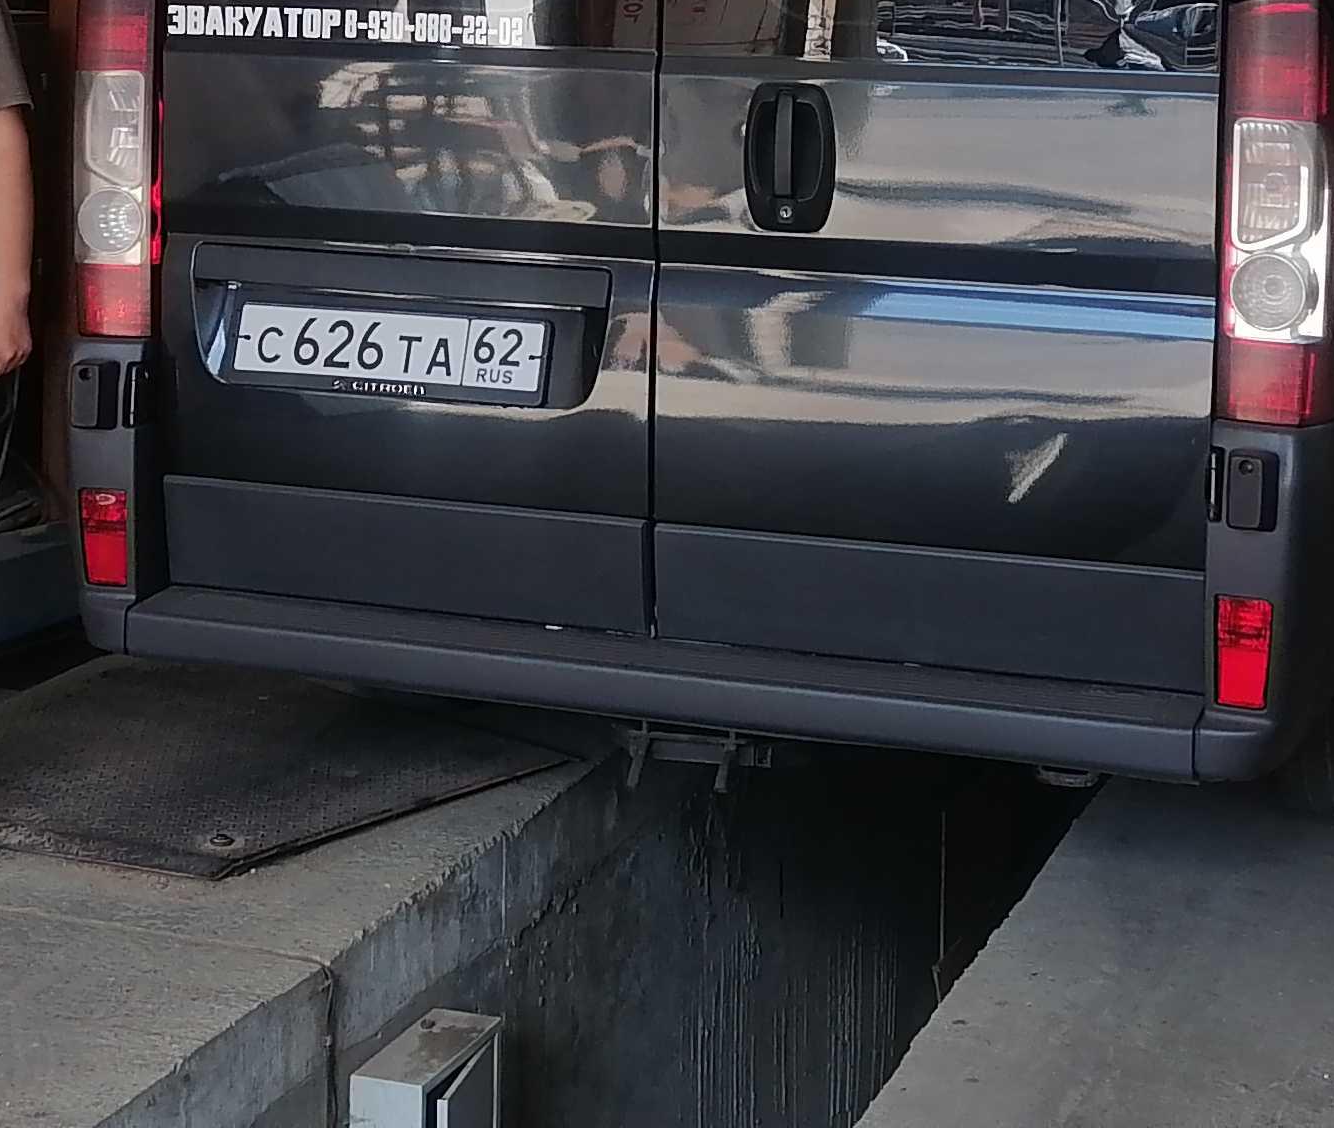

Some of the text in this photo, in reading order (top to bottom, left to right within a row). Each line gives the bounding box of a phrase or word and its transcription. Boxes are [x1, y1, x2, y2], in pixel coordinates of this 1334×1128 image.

[168, 3, 524, 46] ЭВАКУАТОР 8-930-888-22-02
[473, 325, 524, 368] 62
[475, 368, 513, 385] RUS
